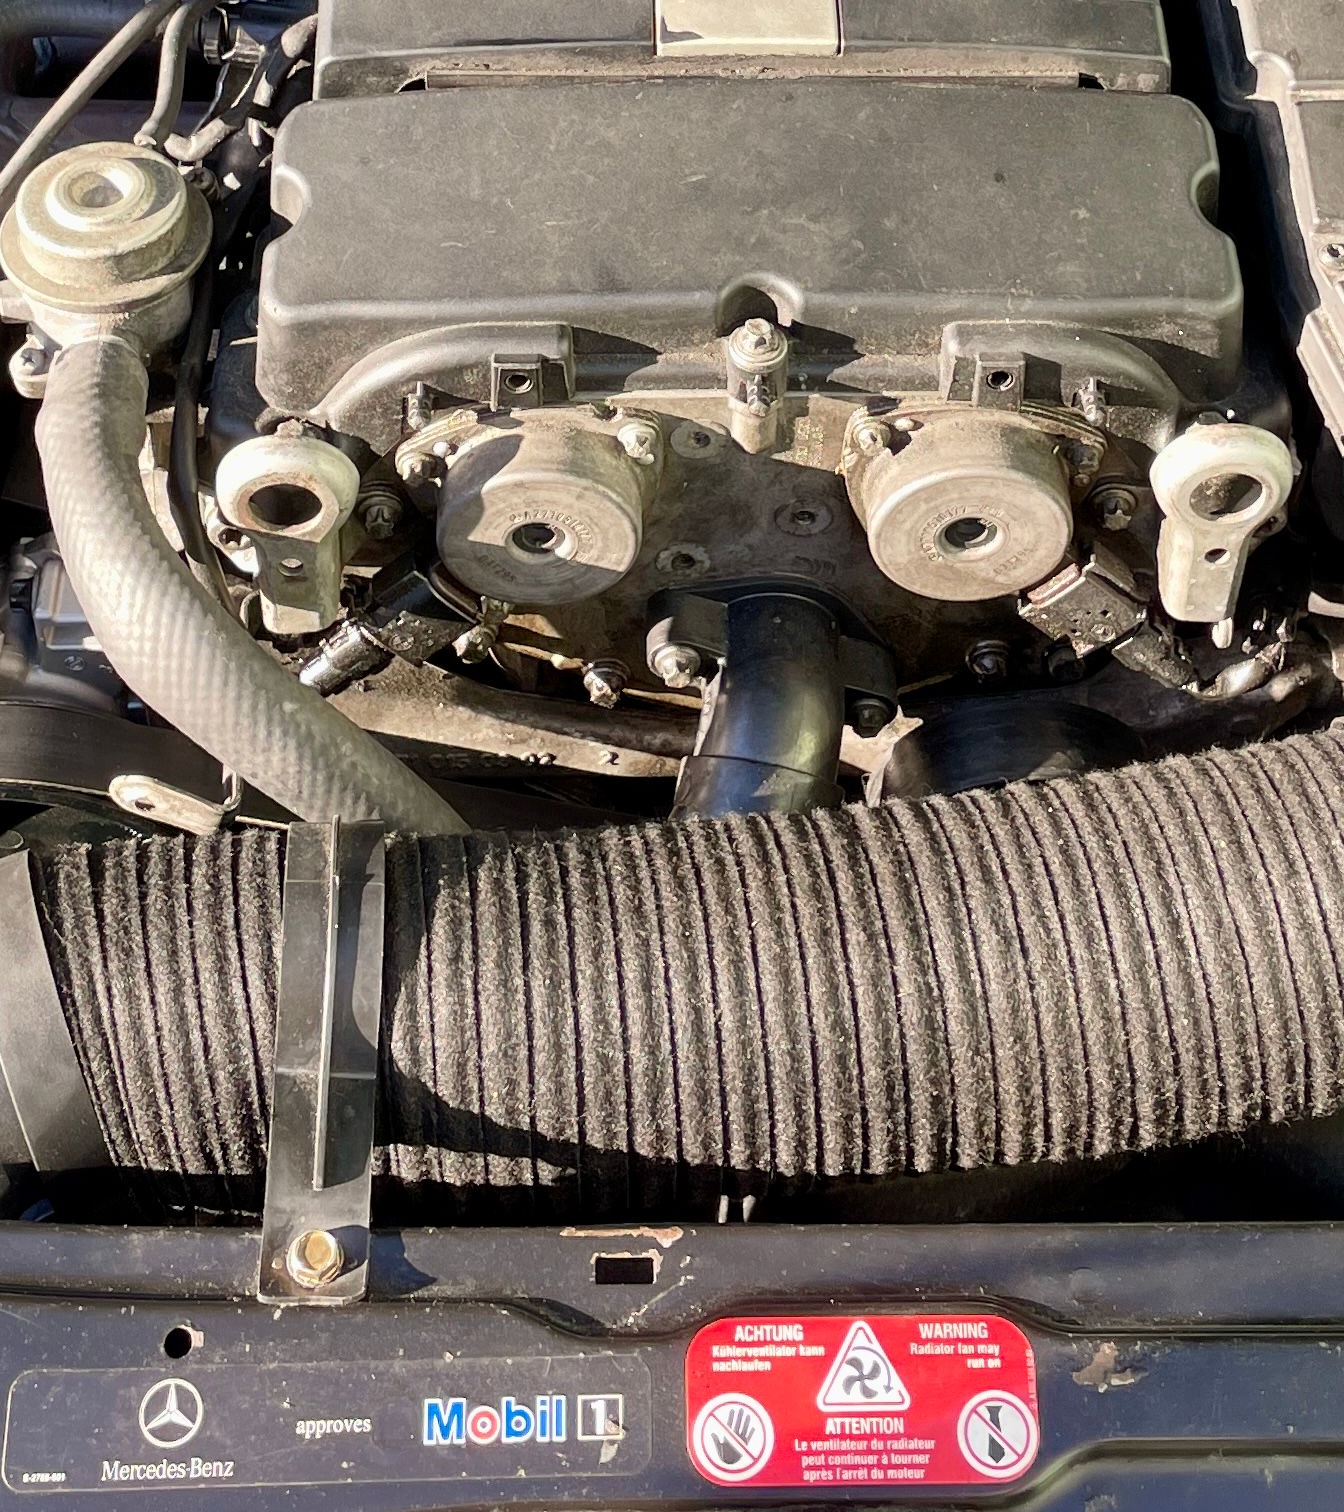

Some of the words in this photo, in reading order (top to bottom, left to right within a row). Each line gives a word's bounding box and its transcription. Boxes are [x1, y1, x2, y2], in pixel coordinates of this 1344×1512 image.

[734, 1324, 804, 1342] ACHTUNG
[918, 1322, 988, 1339] WARNING
[712, 1345, 797, 1358] Kühlerventilator
[799, 1344, 825, 1357] kann
[910, 1342, 955, 1355] Radiator
[957, 1342, 975, 1355] fan
[977, 1344, 1000, 1356] may
[712, 1359, 772, 1372] nachlaufen
[967, 1358, 985, 1369] run
[987, 1358, 1001, 1369] on
[294, 1415, 373, 1439] approves
[422, 1394, 567, 1446] Mobil
[825, 1417, 905, 1435] ATTENTION
[795, 1438, 808, 1451] Le
[810, 1438, 868, 1451] ventilateur
[870, 1438, 884, 1451] du
[886, 1438, 936, 1450] radiateur
[801, 1453, 825, 1468] peut
[828, 1453, 879, 1465] continuer
[881, 1454, 889, 1465] à
[891, 1453, 931, 1465] tourner
[101, 1457, 235, 1483] Mercedes-Benz
[803, 1468, 834, 1483] après
[870, 1467, 884, 1480] du
[887, 1467, 926, 1479] moteur
